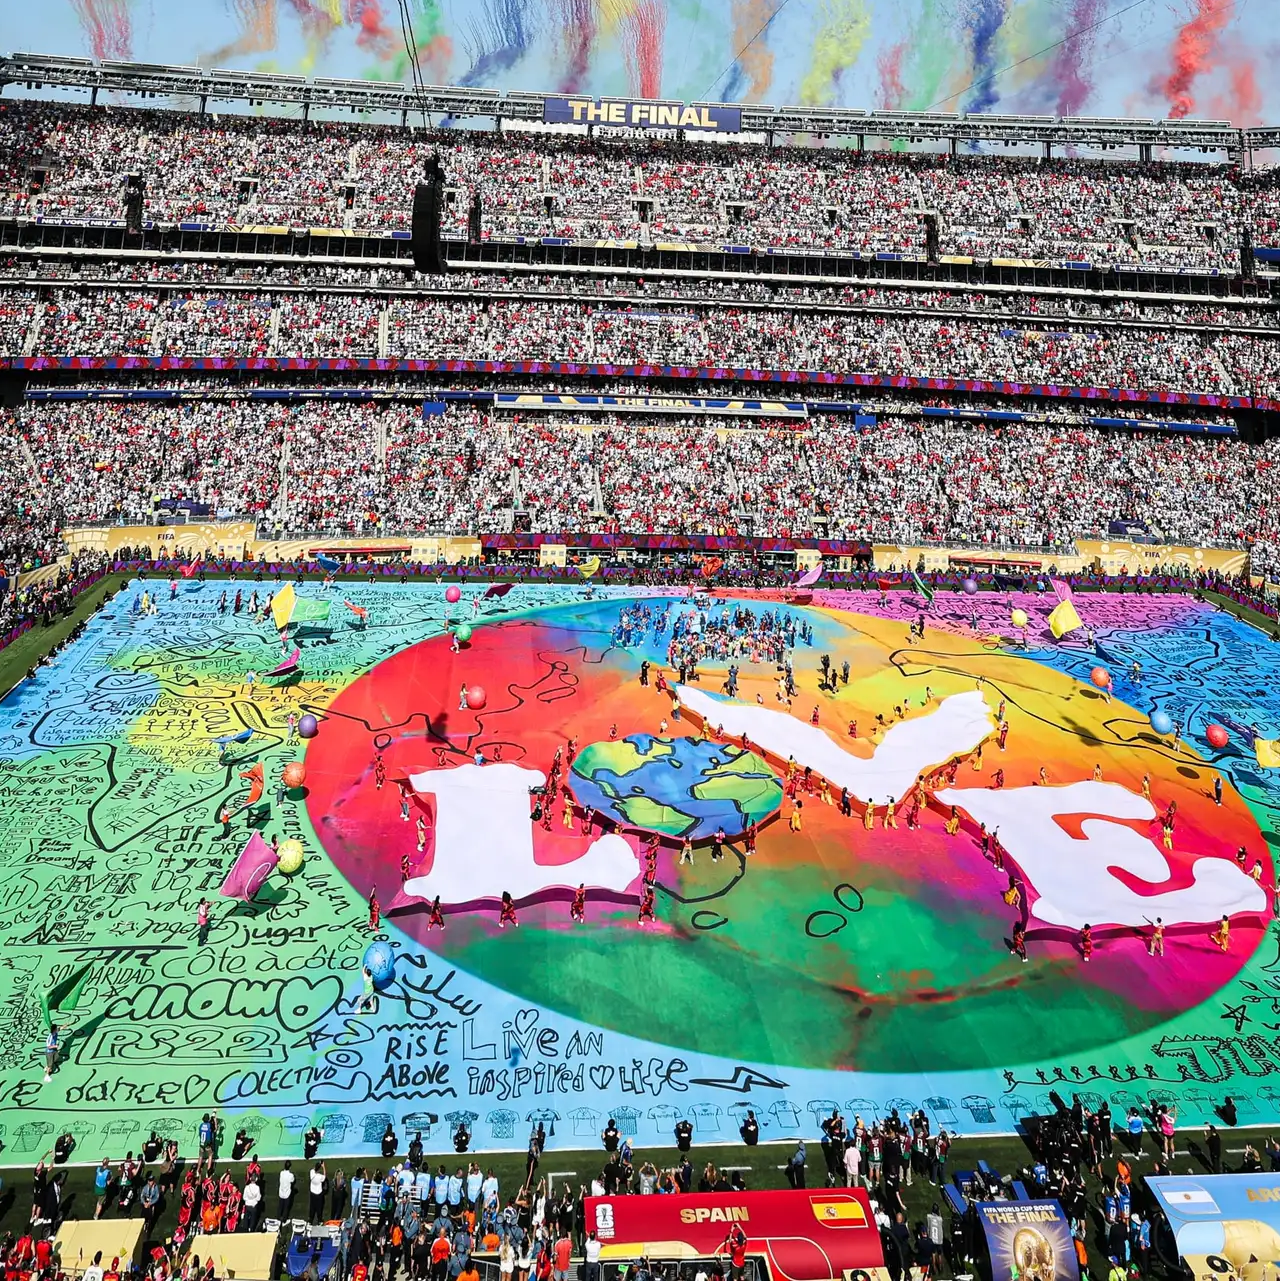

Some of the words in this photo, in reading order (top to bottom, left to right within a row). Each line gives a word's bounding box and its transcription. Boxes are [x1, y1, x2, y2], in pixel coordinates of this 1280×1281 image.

[568, 100, 626, 122] THE
[632, 104, 717, 128] FINAL
[614, 397, 647, 406] THE
[649, 398, 694, 407] FINAL
[50, 711, 141, 728] Future
[113, 707, 193, 717] READING
[126, 747, 163, 755] END
[175, 825, 215, 842] IF
[154, 840, 203, 854] Can
[43, 872, 143, 894] NEVER
[151, 870, 198, 891] DO
[231, 924, 328, 949] jugar
[93, 1027, 275, 1061] PS22
[65, 1068, 182, 1106] dance
[213, 1065, 339, 1104] COLECTIVO
[680, 1206, 750, 1224] SPAIN
[985, 1212, 1017, 1224] THE
[1017, 1210, 1061, 1223] FINAL
